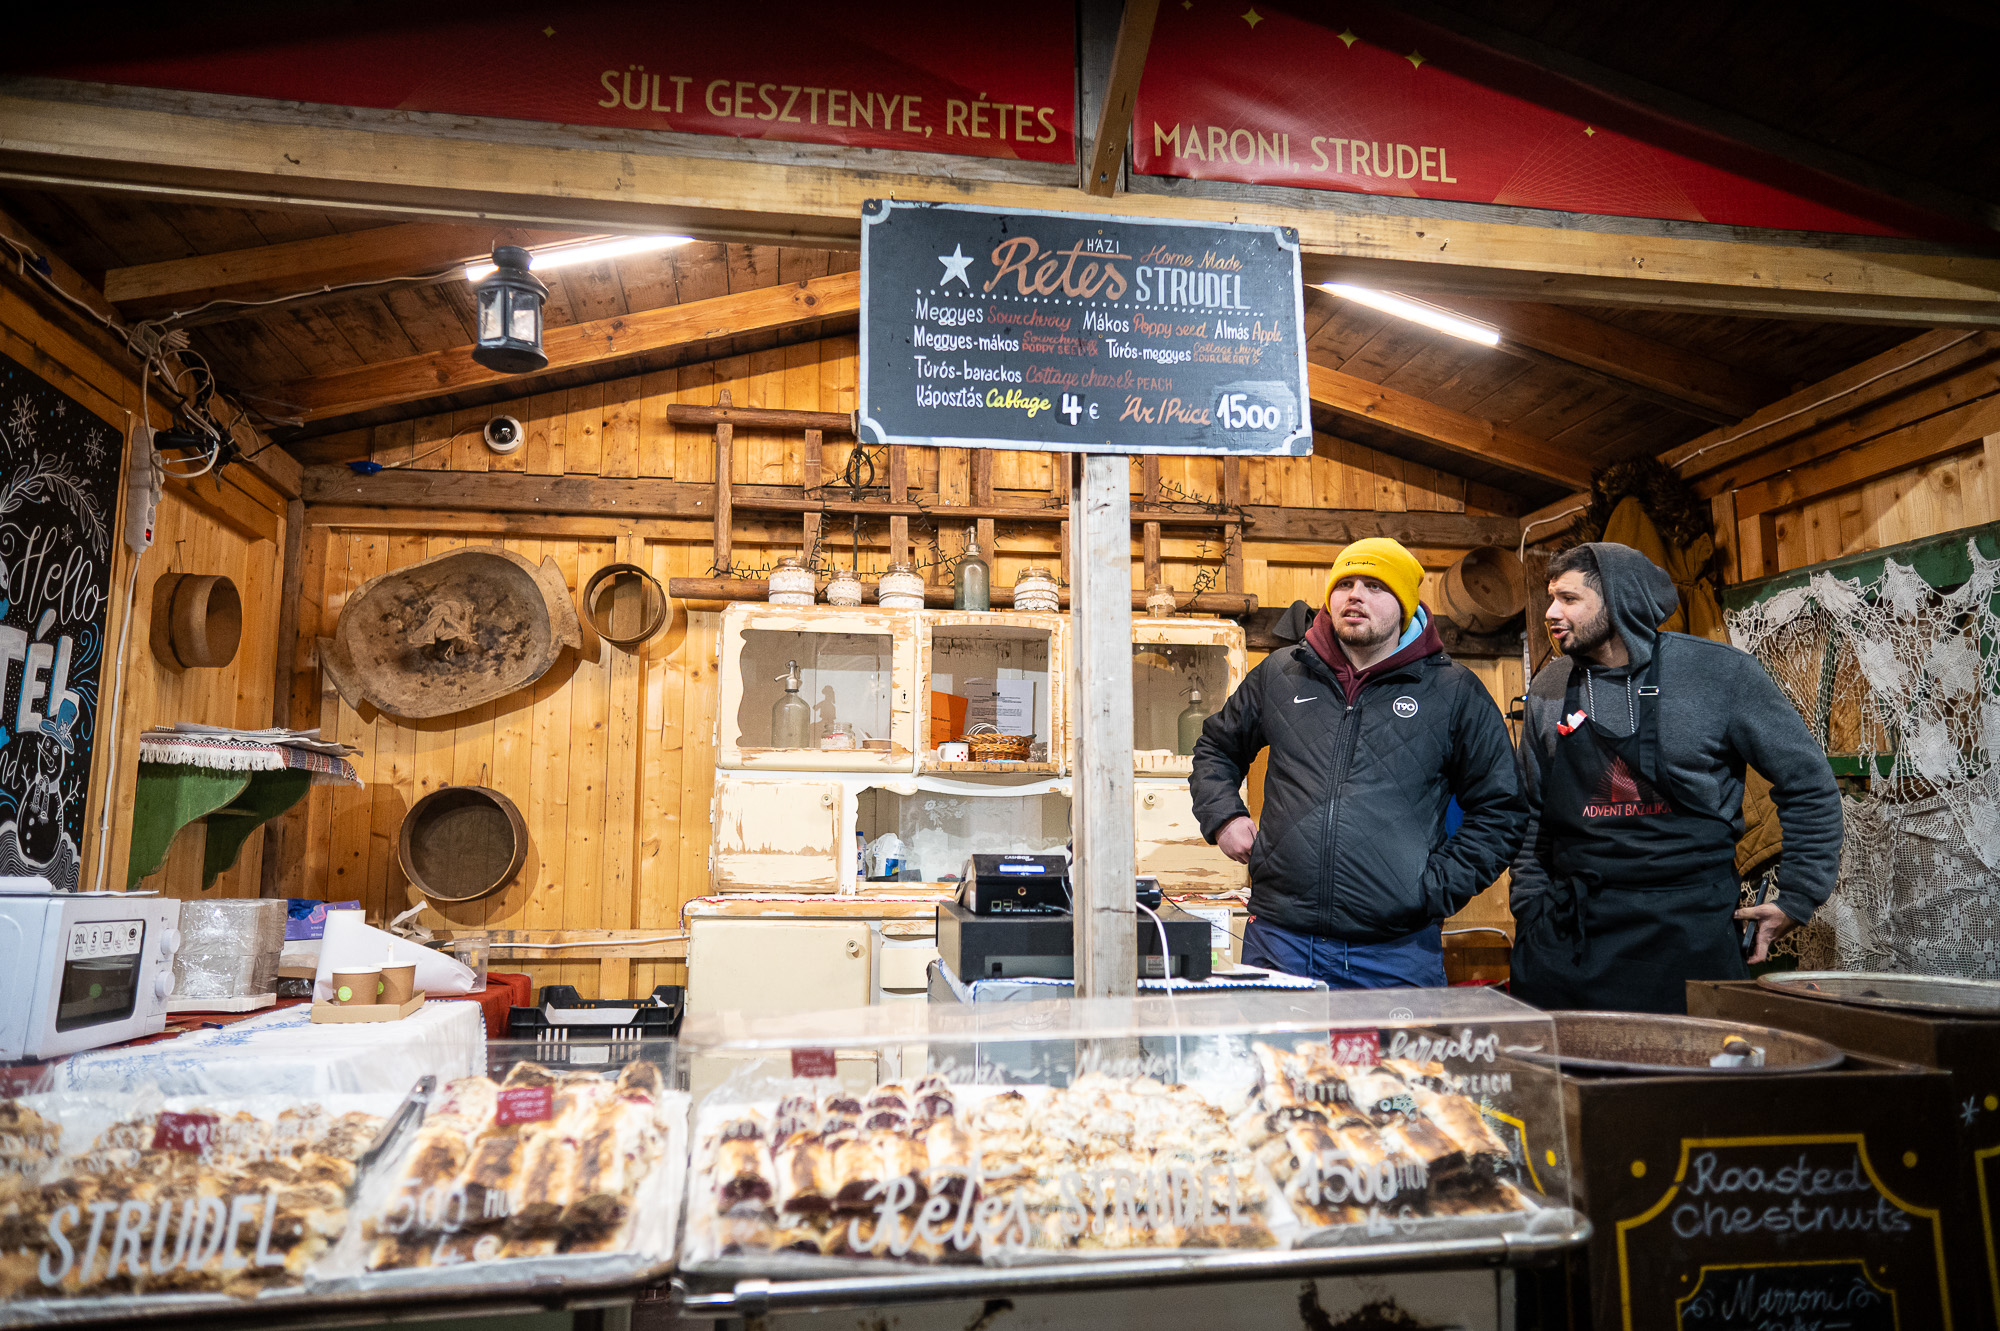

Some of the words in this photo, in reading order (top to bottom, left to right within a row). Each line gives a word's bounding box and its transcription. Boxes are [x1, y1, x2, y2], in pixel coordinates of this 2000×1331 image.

[599, 65, 692, 113] SÜLT
[706, 79, 933, 138] GESZTENYE,
[947, 93, 1057, 144] RÉTES
[1154, 121, 1300, 173] MARONI,
[1310, 136, 1457, 184] STRUDEL
[983, 236, 1132, 300] Rétes
[1087, 239, 1119, 253] HÁZI
[1140, 244, 1193, 267] Home
[1198, 250, 1243, 272] Made
[1136, 266, 1251, 310] STRUDEL
[915, 298, 984, 326] Meggyes
[1083, 310, 1130, 333] Mákos
[1133, 313, 1172, 339] Poppy
[1175, 322, 1208, 338] seed
[1214, 319, 1249, 341] Almás
[1252, 320, 1283, 344] Apple
[914, 325, 1019, 351] Meggyes-mákos
[1106, 339, 1192, 365] Túrós-meggyes
[914, 355, 1023, 383] Túrós-barackos
[1026, 365, 1079, 391] Cottage
[1137, 377, 1173, 391] PEACH
[916, 384, 984, 409] Káposztás
[985, 388, 1052, 418] Cabbage
[1061, 393, 1083, 426] 4
[1088, 402, 1100, 419] €
[1216, 393, 1281, 430] 1500
[8, 525, 108, 626] Hello
[1582, 803, 1623, 818] ADVENT
[1625, 801, 1672, 816] BAZILIKA
[1300, 1149, 1397, 1206] 1500
[1687, 1152, 1872, 1196] Roasted
[848, 1152, 1032, 1256] Rétes
[1060, 1163, 1250, 1235] STRUDEL
[37, 1194, 285, 1287] STRUDEL
